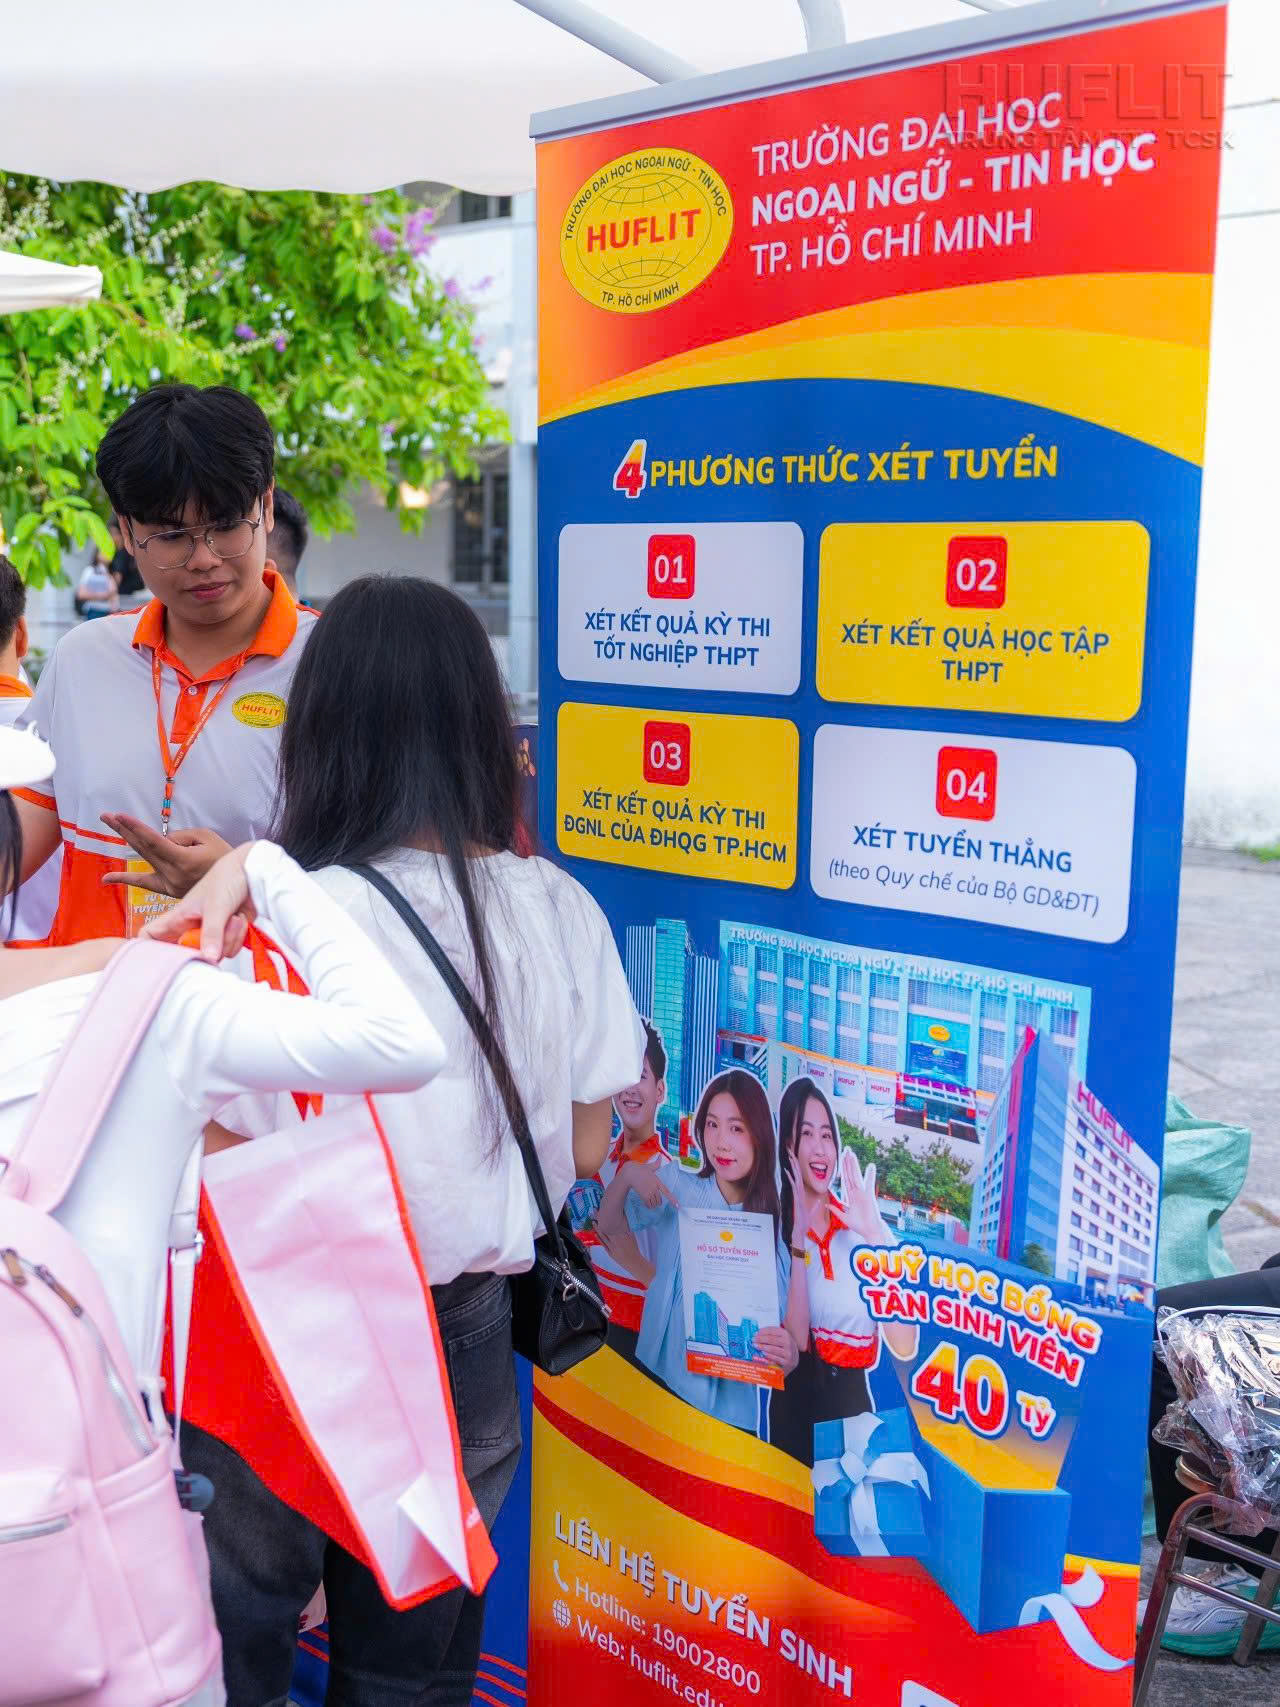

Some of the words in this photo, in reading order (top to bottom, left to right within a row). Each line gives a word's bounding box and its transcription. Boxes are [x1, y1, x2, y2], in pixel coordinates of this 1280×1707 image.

[751, 122, 889, 176] TRƯỜNG
[900, 108, 965, 156] ĐẠI
[977, 91, 1062, 143] HỌC
[565, 189, 593, 241] TRƯỜNG
[592, 173, 609, 193] ĐẠI
[610, 162, 633, 179] HỌC
[635, 155, 666, 170] NGOẠI
[668, 157, 691, 171] NGỮ
[698, 168, 715, 190] TIN
[711, 185, 728, 217] HỌC
[752, 180, 857, 224] NGOẠI
[867, 148, 951, 209] NGỮ
[984, 150, 1051, 192] TIN
[1061, 132, 1157, 187] HỌC
[587, 208, 702, 253] HUFLIT
[750, 242, 791, 275] TP.
[801, 216, 851, 269] HỒ
[862, 212, 926, 261] CHÍ
[933, 207, 1033, 254] MINH
[602, 290, 616, 305] TP.
[618, 292, 633, 307] HỒ
[635, 293, 652, 306] CHÍ
[653, 282, 680, 303] MINH
[614, 439, 648, 498] 4
[650, 454, 775, 487] PHƯƠNG
[782, 445, 859, 484] THỨC
[867, 442, 934, 481] XÉT
[944, 433, 1058, 480] TUYỂN
[654, 554, 687, 584] 01
[955, 558, 998, 592] 02
[584, 608, 616, 630] XÉT
[620, 607, 652, 632] KẾT
[656, 610, 699, 637] QUẢ
[704, 611, 733, 636] KỲ
[737, 617, 771, 637] THI
[841, 618, 883, 645] XÉT
[890, 618, 936, 646] KẾT
[943, 622, 995, 651] QUẢ
[1003, 629, 1053, 657] HỌC
[1061, 625, 1110, 660] TẬP
[593, 634, 626, 660] TỐT
[630, 639, 698, 668] NGHIỆP
[703, 646, 760, 667] THPT
[941, 659, 1004, 683] THPT
[241, 703, 281, 717] HUFLIT
[649, 740, 682, 771] 03
[582, 787, 612, 810] XÉT
[616, 790, 647, 816] KẾT
[651, 797, 694, 823] QUẢ
[699, 800, 727, 825] KỲ
[732, 808, 765, 830] THI
[946, 768, 988, 804] 04
[564, 814, 606, 838] ĐGNL
[610, 818, 645, 844] CỦA
[650, 828, 707, 855] ĐHQG
[713, 835, 787, 864] TP.HCM
[853, 822, 897, 849] XÉT
[903, 829, 982, 860] TUYỂN
[989, 837, 1072, 874] THẲNG
[829, 858, 870, 880] (theo
[875, 865, 914, 890] Quy
[920, 870, 951, 891] chế
[956, 875, 989, 897] của
[994, 882, 1018, 905] Bộ
[1023, 885, 1101, 918] GD&ĐT)
[1077, 1080, 1135, 1154] HUFLIT
[855, 1247, 925, 1283] QUỸ
[930, 1259, 998, 1300] HỌC
[1004, 1284, 1101, 1351] BỔNG
[866, 1283, 928, 1320] TÂN
[935, 1297, 1003, 1345] SINH
[1009, 1322, 1082, 1384] VIÊN
[913, 1343, 1007, 1435] 40
[555, 1512, 611, 1566] LIÊN
[620, 1544, 656, 1597] HỆ
[662, 1569, 770, 1648] TUYỂN
[778, 1628, 852, 1697] SINH
[575, 1577, 646, 1635] Hotline:
[653, 1622, 761, 1694] 19002800
[576, 1615, 624, 1661] Web:
